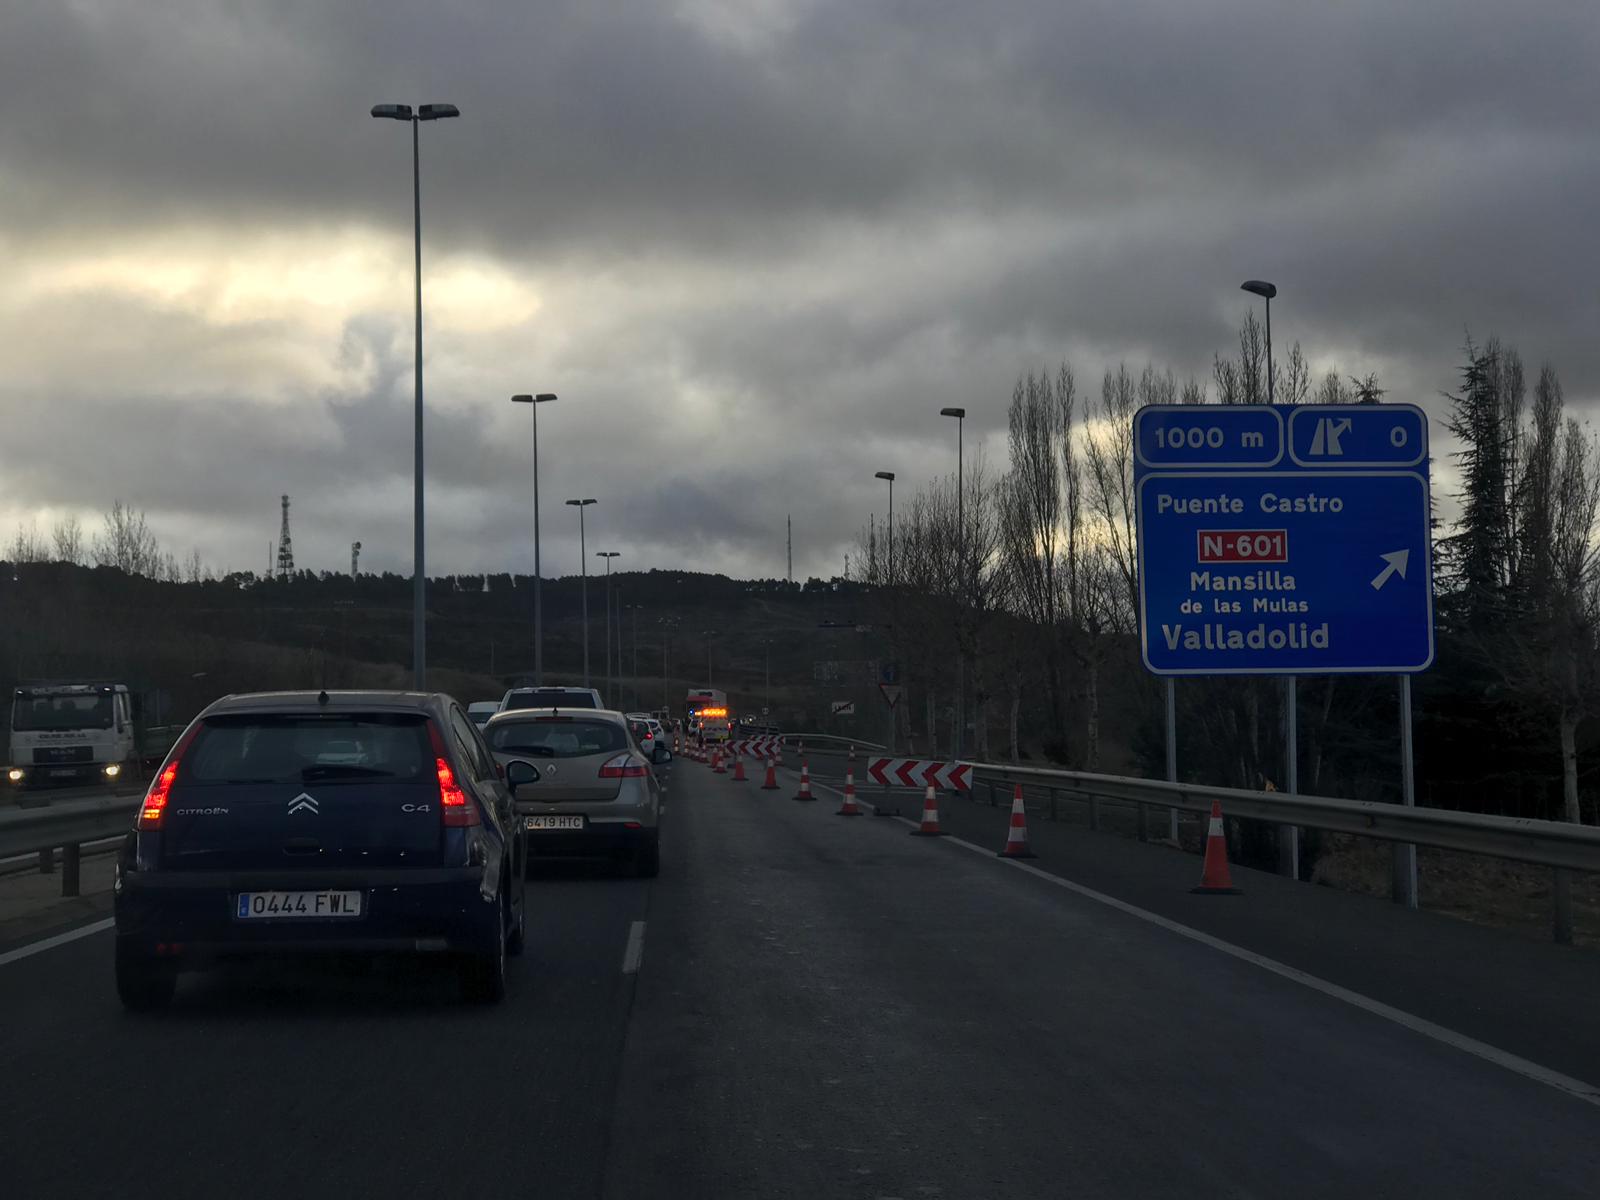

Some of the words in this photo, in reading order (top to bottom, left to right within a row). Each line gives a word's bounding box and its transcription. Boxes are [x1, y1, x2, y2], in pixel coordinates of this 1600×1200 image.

[1155, 427, 1224, 448] 1000
[1241, 431, 1264, 448] m
[1390, 426, 1408, 448] 0
[1157, 494, 1244, 514] Puente
[1259, 493, 1344, 514] Castro
[1203, 535, 1283, 557] N-601
[1190, 571, 1296, 592] Mansilla
[1180, 598, 1203, 614] de
[1214, 598, 1242, 614] las
[1252, 598, 1309, 614] Mulas
[1162, 623, 1329, 650] Valladolid
[400, 802, 431, 813] C4
[527, 817, 556, 828] 6419
[560, 817, 580, 828] HTC
[253, 894, 307, 914] 0444
[315, 894, 354, 912] FWL
